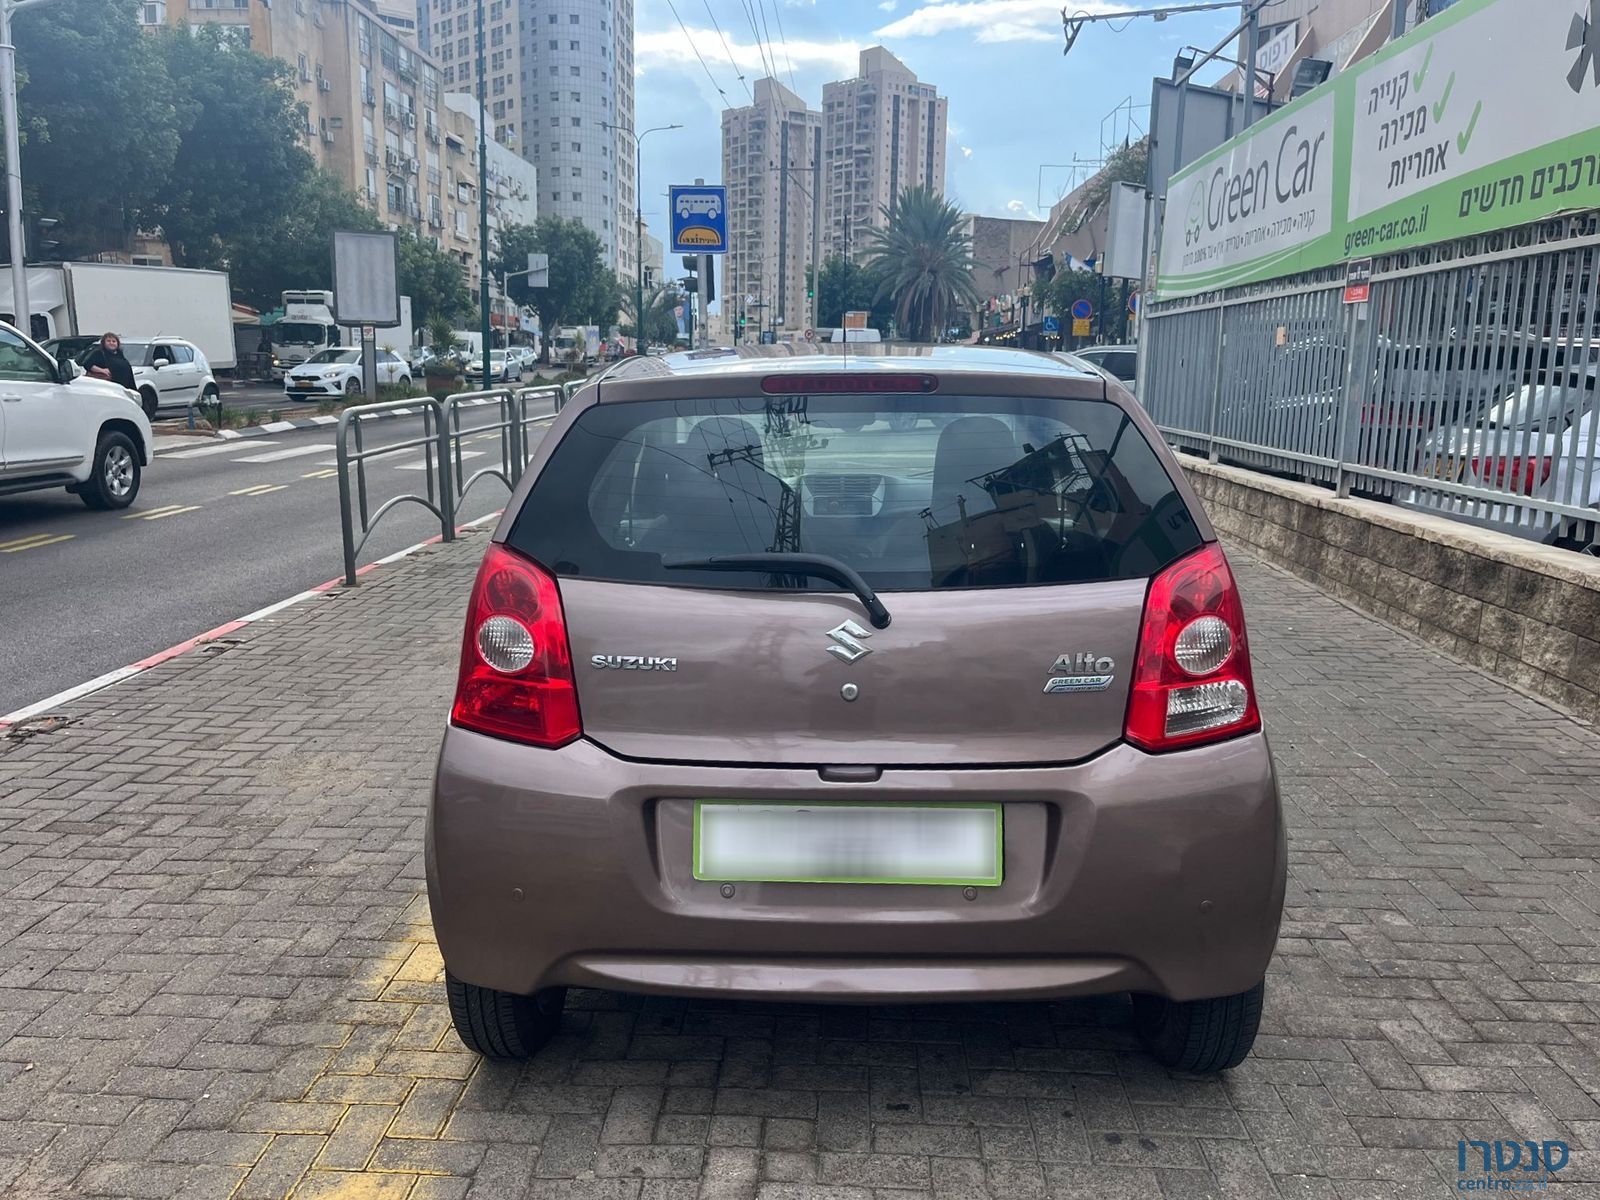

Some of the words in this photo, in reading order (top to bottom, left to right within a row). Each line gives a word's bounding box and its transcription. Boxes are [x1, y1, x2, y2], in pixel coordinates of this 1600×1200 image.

[1260, 33, 1289, 69] דפוס
[1368, 70, 1409, 115] קנייה
[1379, 105, 1427, 151] מכירה
[1207, 166, 1269, 231] Green
[1275, 125, 1325, 204] Car
[1388, 140, 1449, 189] אחריות
[1530, 154, 1600, 200] רכבים
[1458, 174, 1524, 218] חדשים
[1344, 204, 1429, 256] green-car.co.il
[591, 655, 677, 671] SUZUKI
[1047, 651, 1115, 675] Alto
